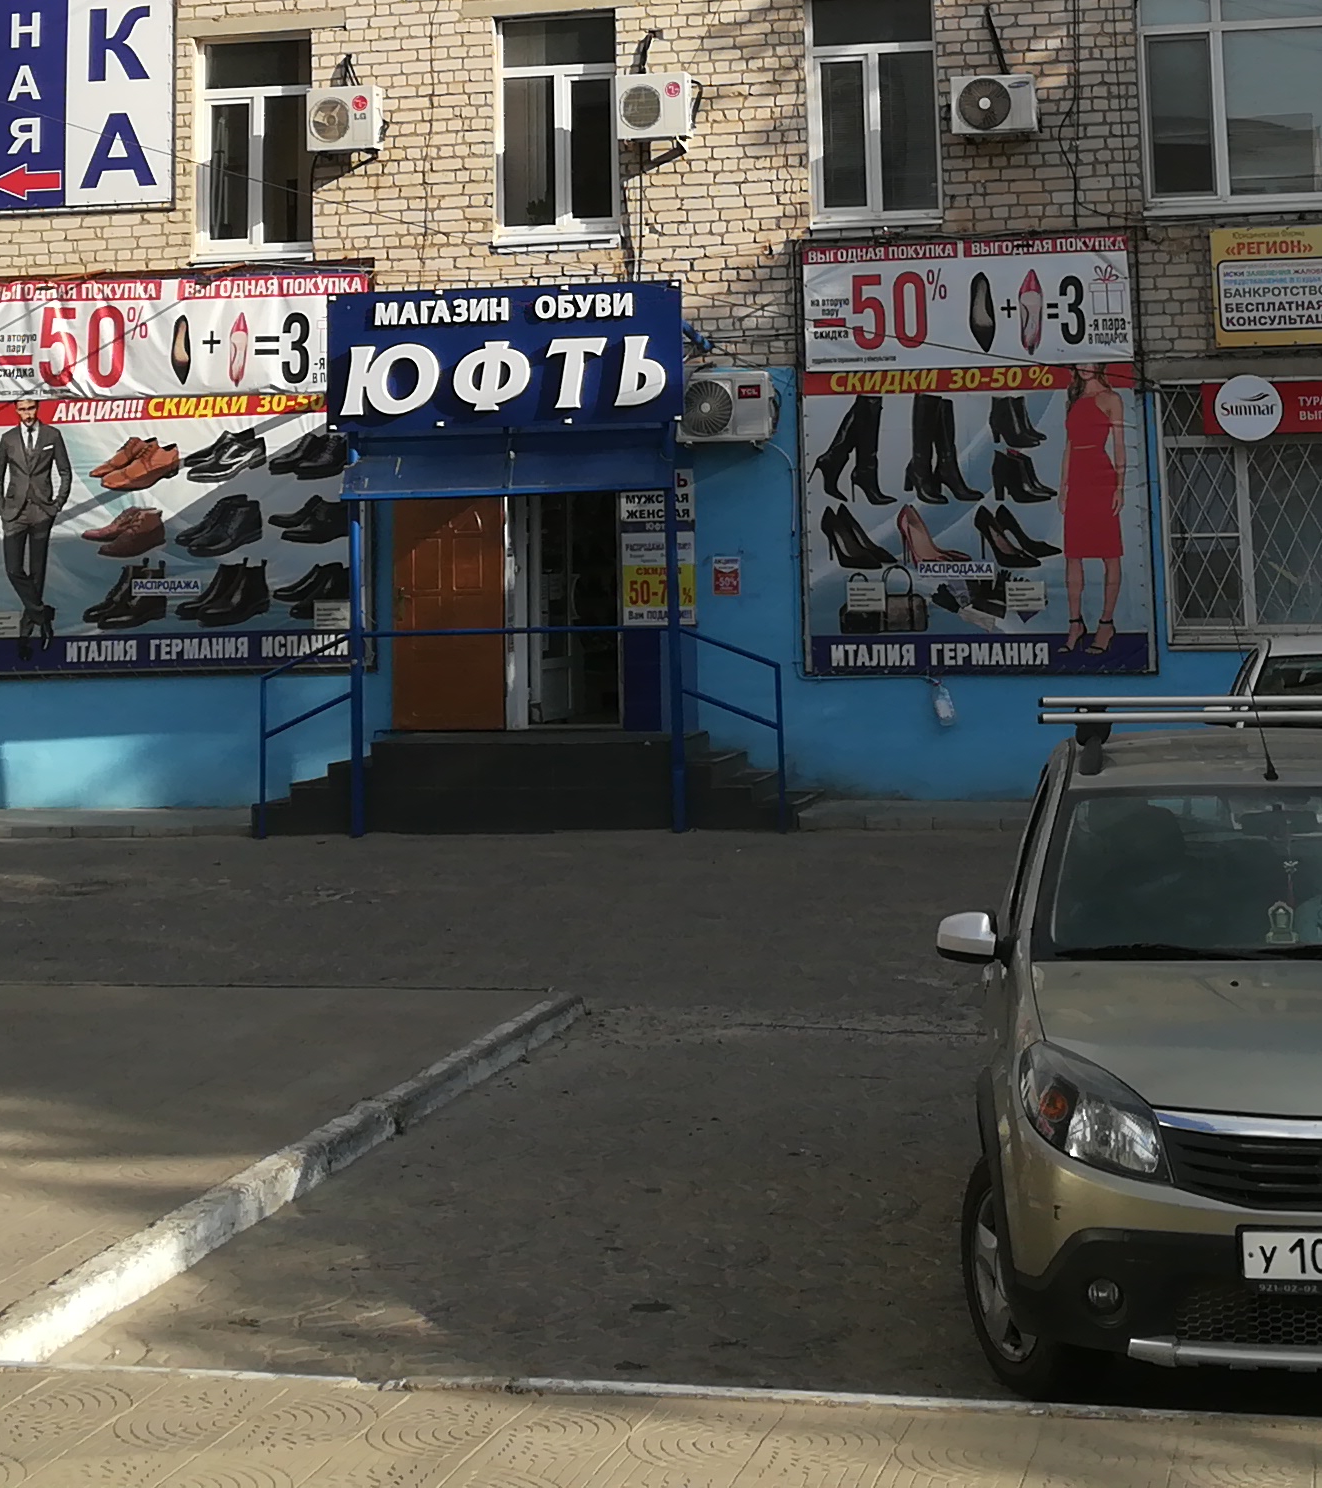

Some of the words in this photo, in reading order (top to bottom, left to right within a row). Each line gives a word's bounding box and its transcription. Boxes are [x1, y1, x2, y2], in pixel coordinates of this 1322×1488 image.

[808, 246, 885, 263] ВЫГОДНАЯ
[888, 244, 955, 260] ПОКУПКА
[971, 239, 1052, 256] ВЫГОДНАЯ
[1056, 237, 1126, 252] ПОКУПКА
[1224, 240, 1313, 256] «РЕГИОН»
[82, 282, 156, 299] ПОКУПКА
[184, 277, 277, 299] ВЫГОДНАЯ
[283, 276, 363, 294] ПОКУПКА
[374, 296, 510, 326] МАГАЗИН
[535, 292, 634, 320] ОБУВИ
[813, 328, 849, 341] скидка
[1101, 317, 1126, 336] пара
[1095, 332, 1129, 346] ПОДАРОК
[339, 335, 667, 416] ЮФТЬ
[829, 368, 939, 395] СКИДКИ
[948, 367, 1022, 389] 30-50
[52, 398, 144, 423] АКЦИЯ!!!
[147, 395, 247, 420] СКИДКИ
[1220, 401, 1277, 417] Sunmar
[625, 492, 689, 505] МУЖСАЯ
[625, 508, 690, 520] ЖЕНСАЯ
[919, 563, 993, 576] РАСПРОДАЖА
[133, 580, 200, 592] РАСПРОДАЖА
[65, 640, 137, 663] ИТАЛИЯ
[149, 637, 248, 661] ГЕРМАНИЯ
[261, 633, 348, 657] ИСПАНИЯ
[830, 643, 916, 668] ИТАЛИЯ
[930, 641, 1049, 667] ГЕРМАНИЯ
